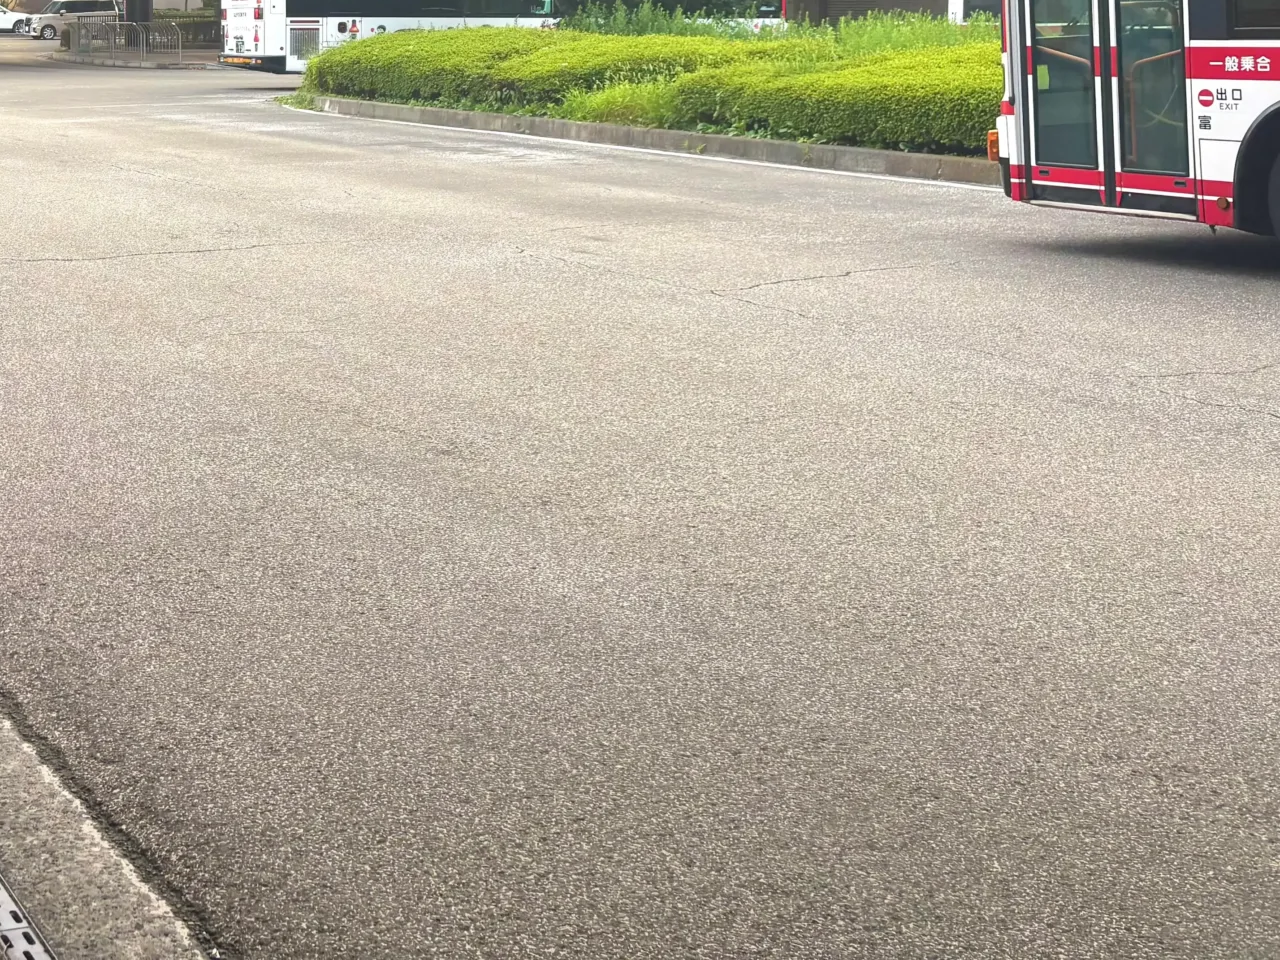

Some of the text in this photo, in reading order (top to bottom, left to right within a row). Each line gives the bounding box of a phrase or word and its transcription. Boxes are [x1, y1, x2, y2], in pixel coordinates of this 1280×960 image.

[1209, 55, 1271, 72] 一般乗合
[1215, 87, 1243, 101] 出口
[1219, 103, 1239, 111] EXIT
[1198, 115, 1212, 130] 富
